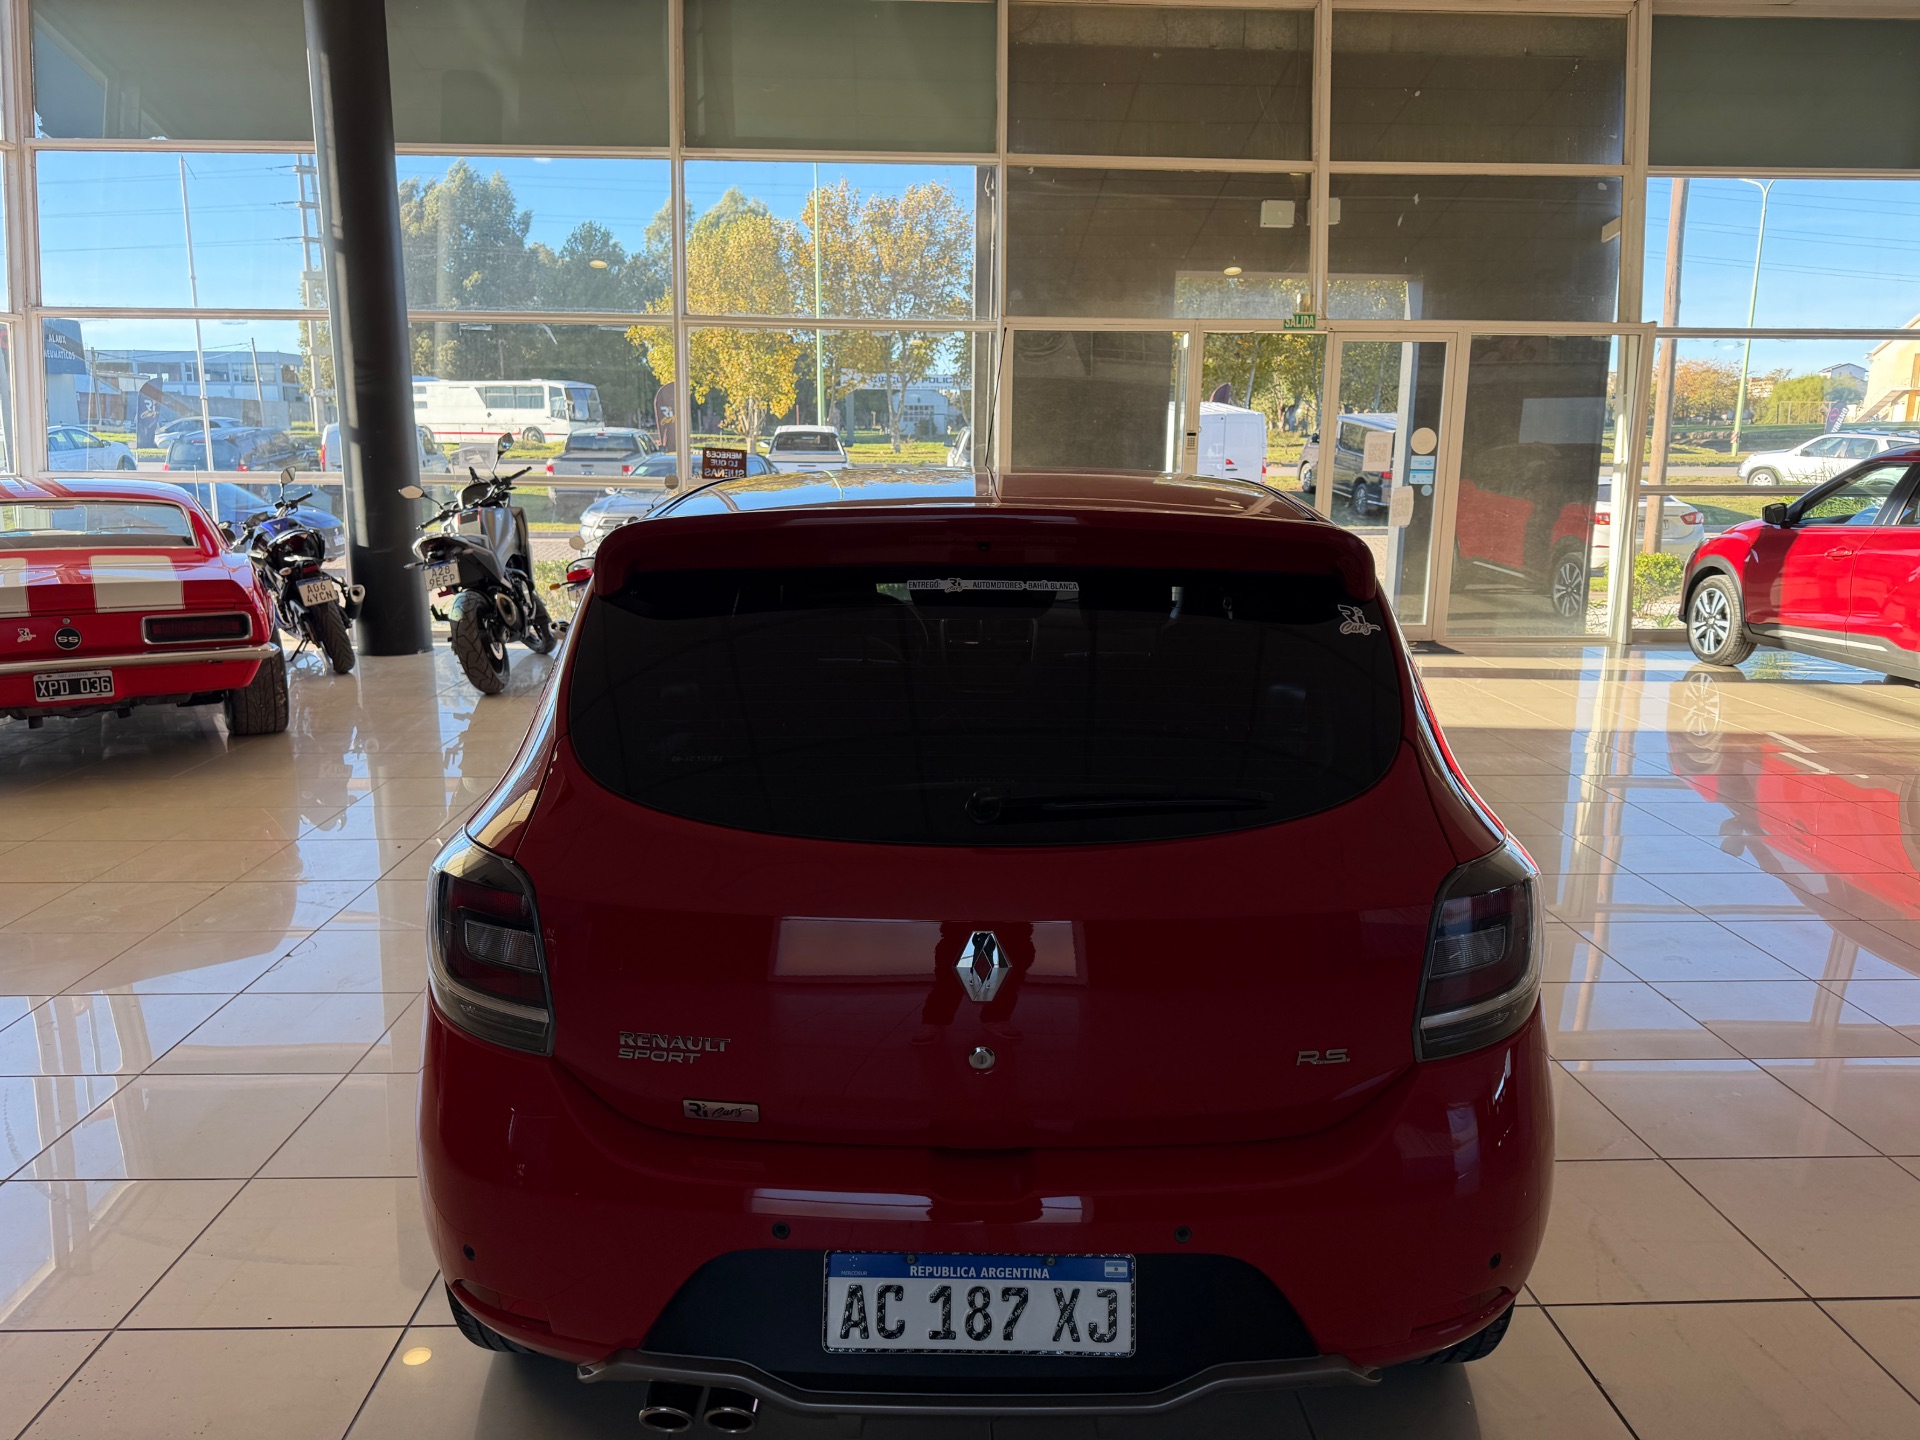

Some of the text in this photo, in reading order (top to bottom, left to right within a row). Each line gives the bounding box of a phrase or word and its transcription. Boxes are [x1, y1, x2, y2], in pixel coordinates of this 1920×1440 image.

[1285, 315, 1315, 328] SALIDA
[48, 334, 67, 344] ALAUX
[432, 565, 451, 578] A28
[429, 574, 455, 588] 9EFP
[972, 581, 1023, 589] AUTOMOTORES
[1051, 582, 1078, 590] BLANCA
[307, 590, 333, 604] 4YCN
[1340, 621, 1380, 635] Cars
[57, 635, 79, 643] SS
[38, 676, 111, 697] XPD 036
[619, 1030, 731, 1052] RENAULT
[618, 1047, 701, 1064] SPORT
[711, 1106, 753, 1119] Cars
[909, 1265, 1050, 1279] REPUBLICA ARGENTINA
[839, 1284, 1118, 1343] AC 187 XJ
